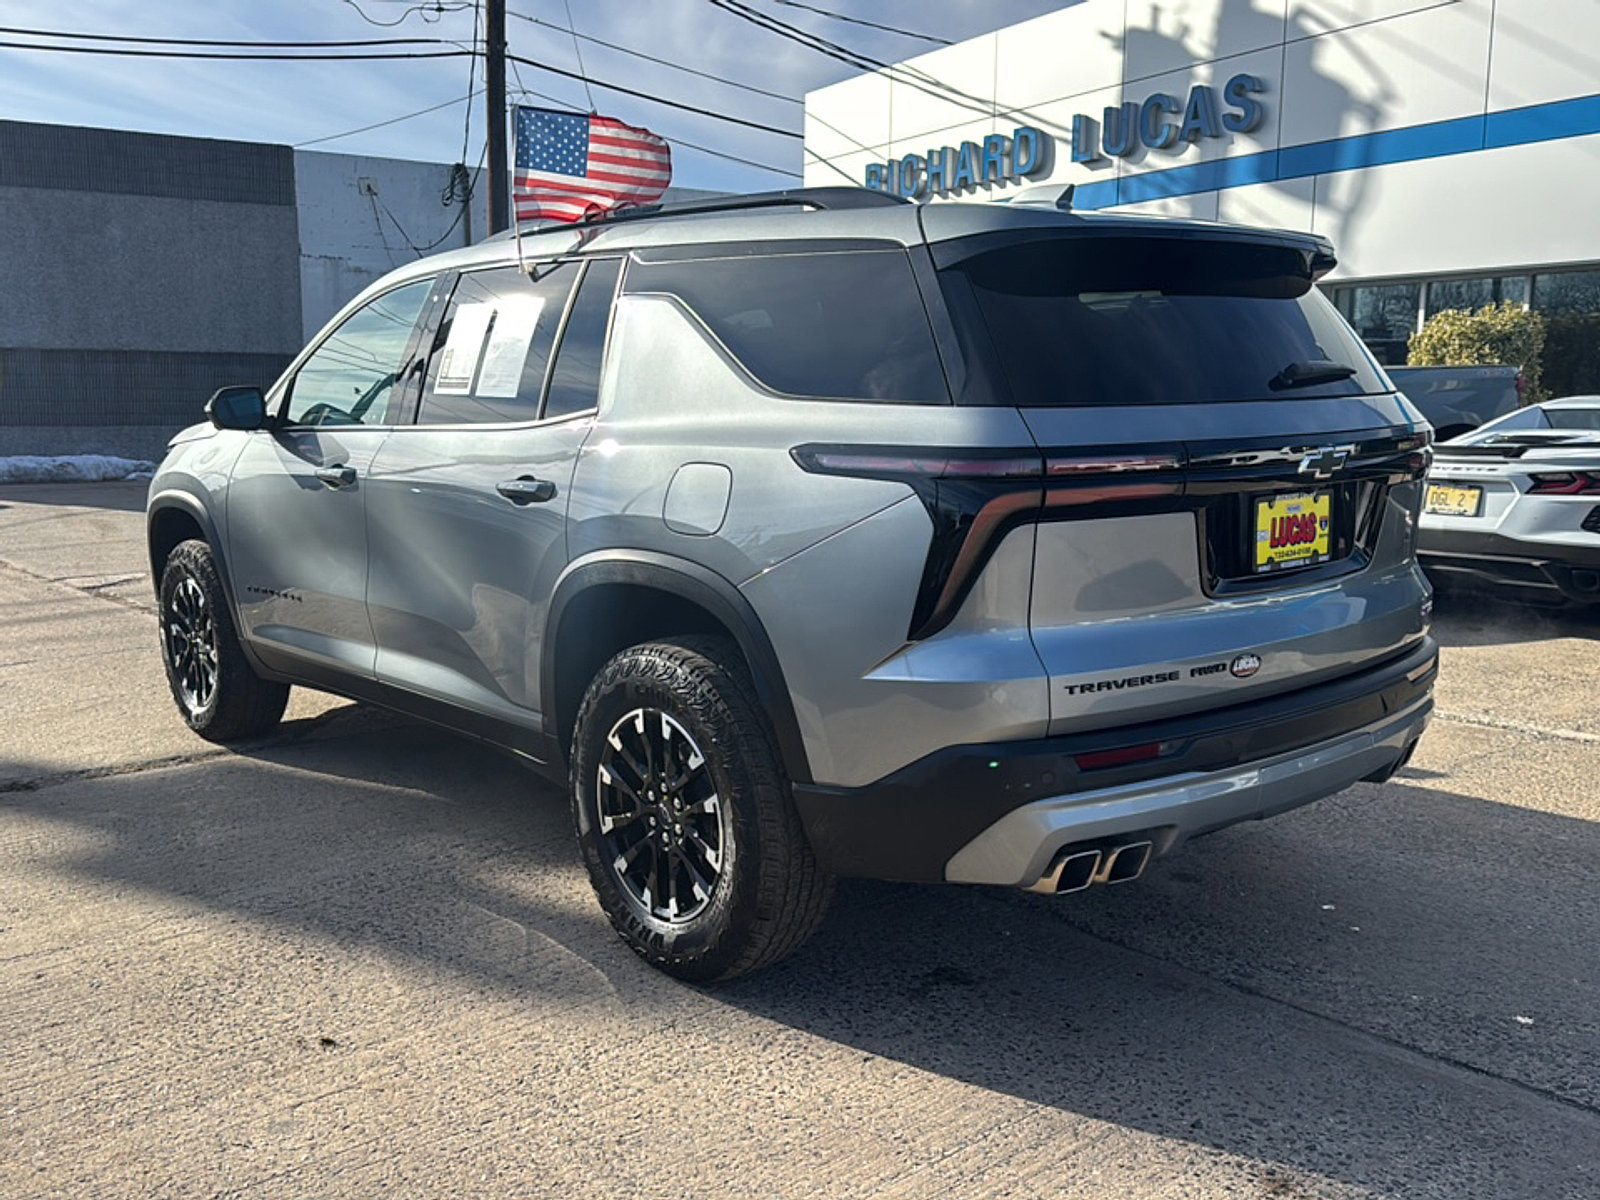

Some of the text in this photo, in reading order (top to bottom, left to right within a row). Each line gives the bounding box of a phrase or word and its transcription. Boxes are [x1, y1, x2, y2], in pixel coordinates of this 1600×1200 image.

[866, 73, 1266, 200] RICHARD LUCAS
[1270, 513, 1317, 548] LUCAS
[1064, 661, 1228, 695] TRAVERSE AWD
[1233, 653, 1261, 672] LUCAS
